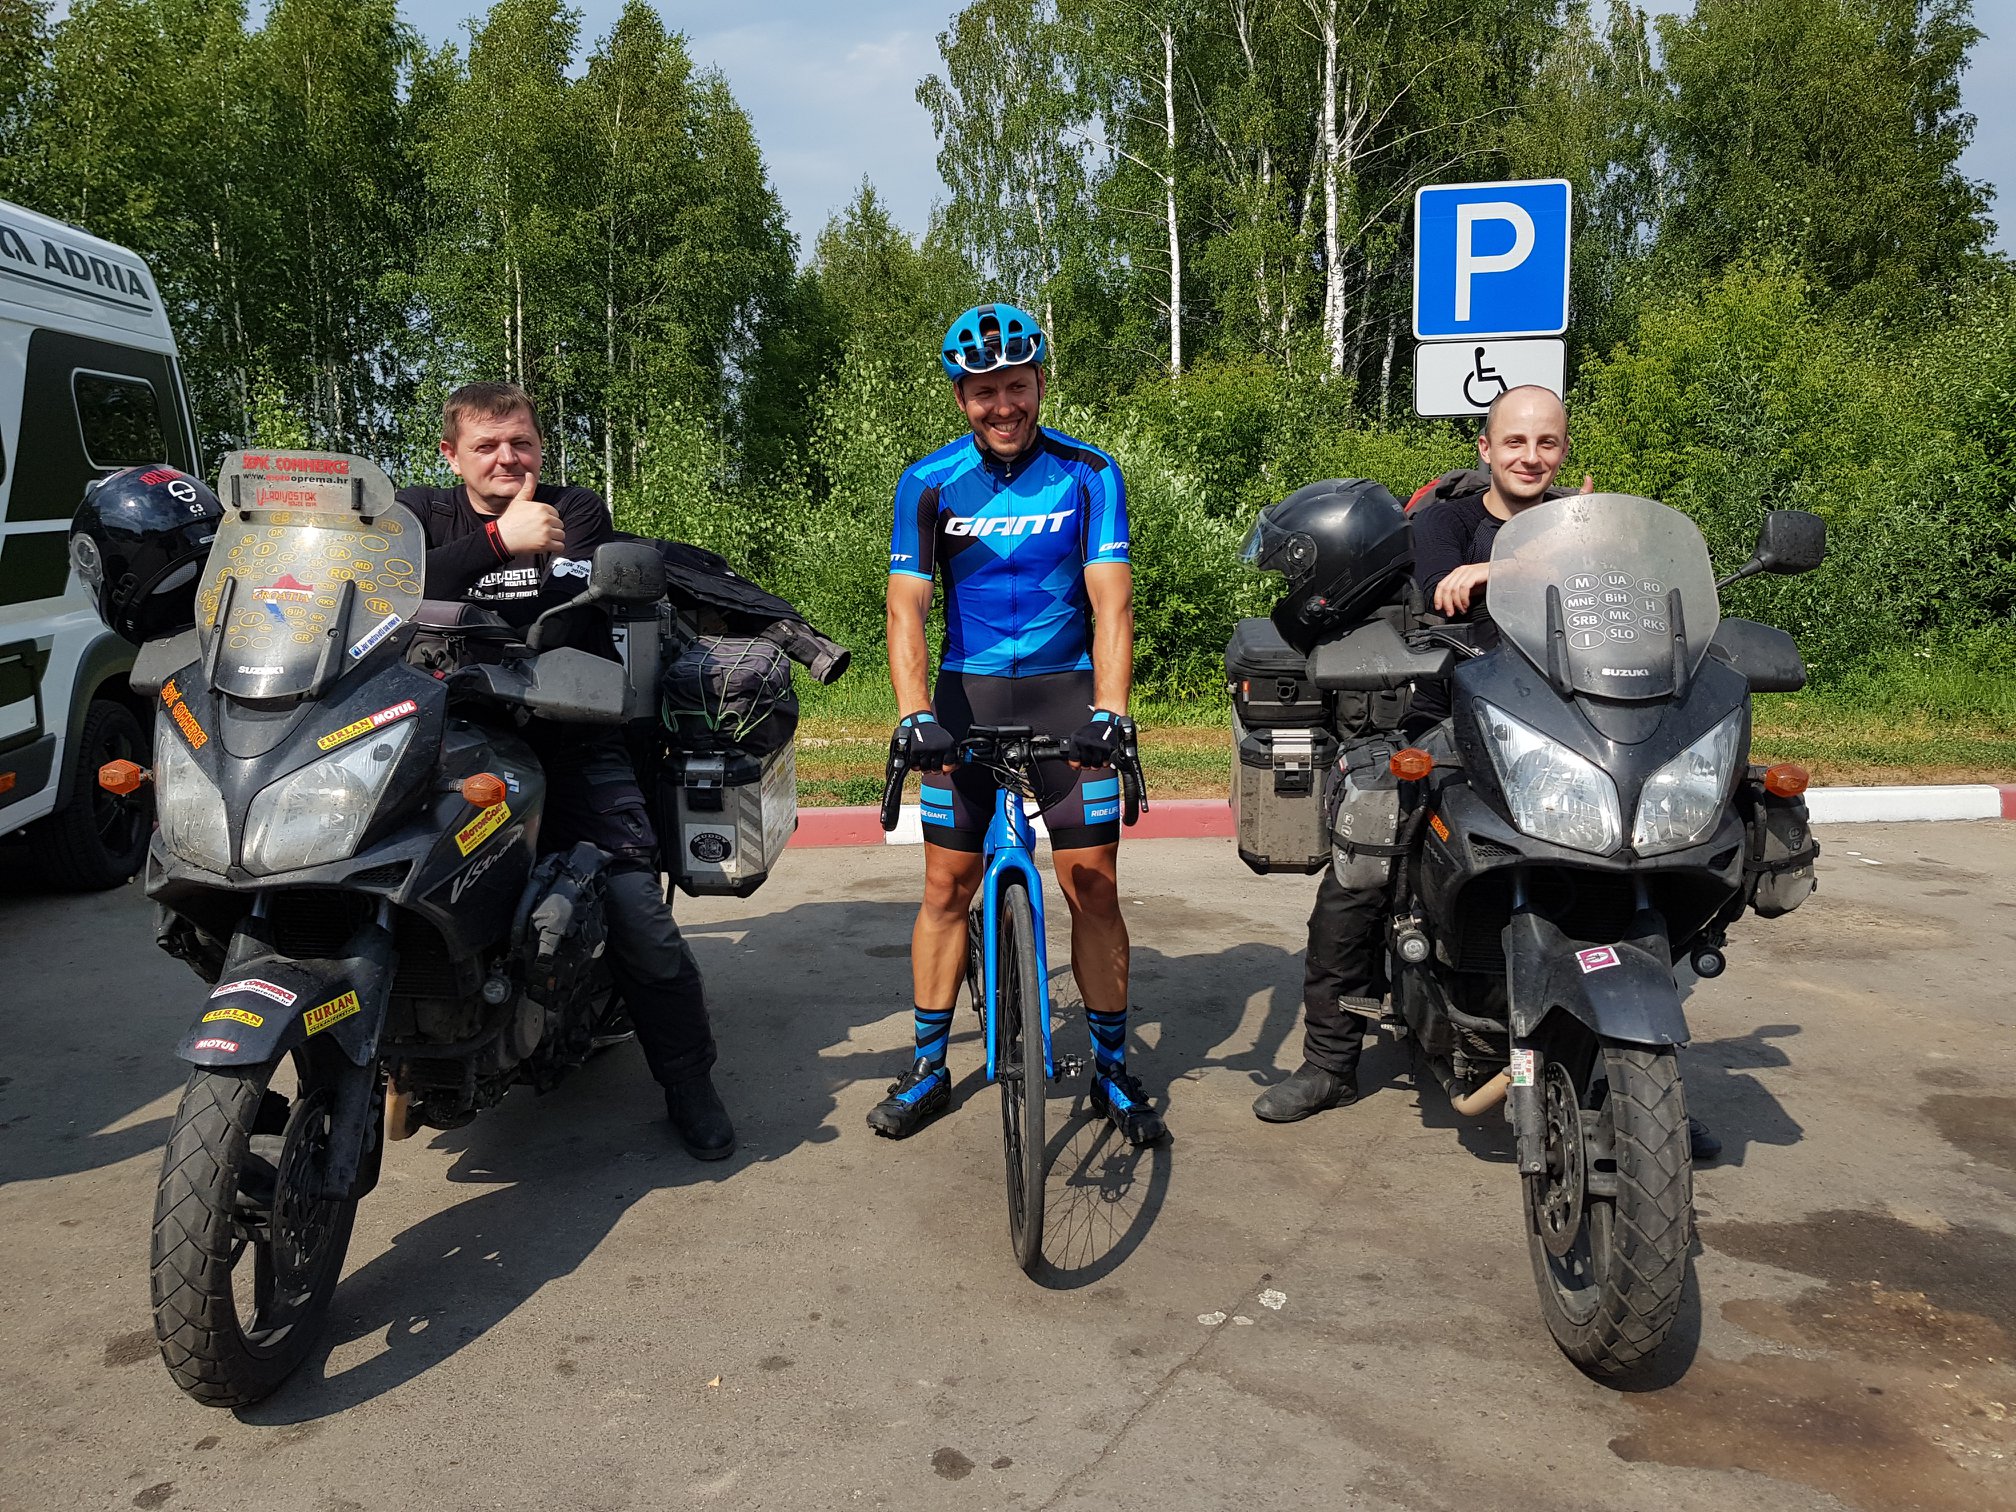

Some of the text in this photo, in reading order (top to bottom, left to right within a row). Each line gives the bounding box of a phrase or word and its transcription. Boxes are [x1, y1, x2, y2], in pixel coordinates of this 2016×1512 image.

[1455, 202, 1535, 322] P
[40, 238, 151, 301] ADRIA
[276, 458, 349, 475] COMMERCE
[381, 522, 399, 533] FIN
[944, 509, 1076, 537] GIANT
[1098, 541, 1129, 552] GIA
[329, 549, 347, 559] UA
[355, 561, 371, 570] MD
[331, 568, 351, 579] RO
[1575, 577, 1590, 589] M
[1608, 575, 1627, 585] UA
[1643, 582, 1660, 593] RO
[252, 590, 310, 603] CROATIA
[1605, 593, 1627, 603] BiH
[371, 600, 388, 612] TR
[1567, 597, 1595, 608] MNE
[1645, 601, 1656, 611] H
[1572, 615, 1598, 626] SRB
[1609, 611, 1631, 620] MK
[1643, 619, 1666, 631] RKS
[1610, 628, 1634, 639] SLO
[238, 665, 284, 675] SUZUKI
[1601, 668, 1649, 677] SUZUKI
[373, 702, 415, 726] MOTUL
[172, 701, 208, 750] COMMERCE
[319, 719, 370, 746] FURLAN
[1091, 808, 1109, 818] RIDE
[244, 980, 295, 1001] COMMERCE
[306, 993, 355, 1026] FURLAN
[204, 1010, 261, 1024] FURLAN
[197, 1040, 236, 1052] MOTUL
